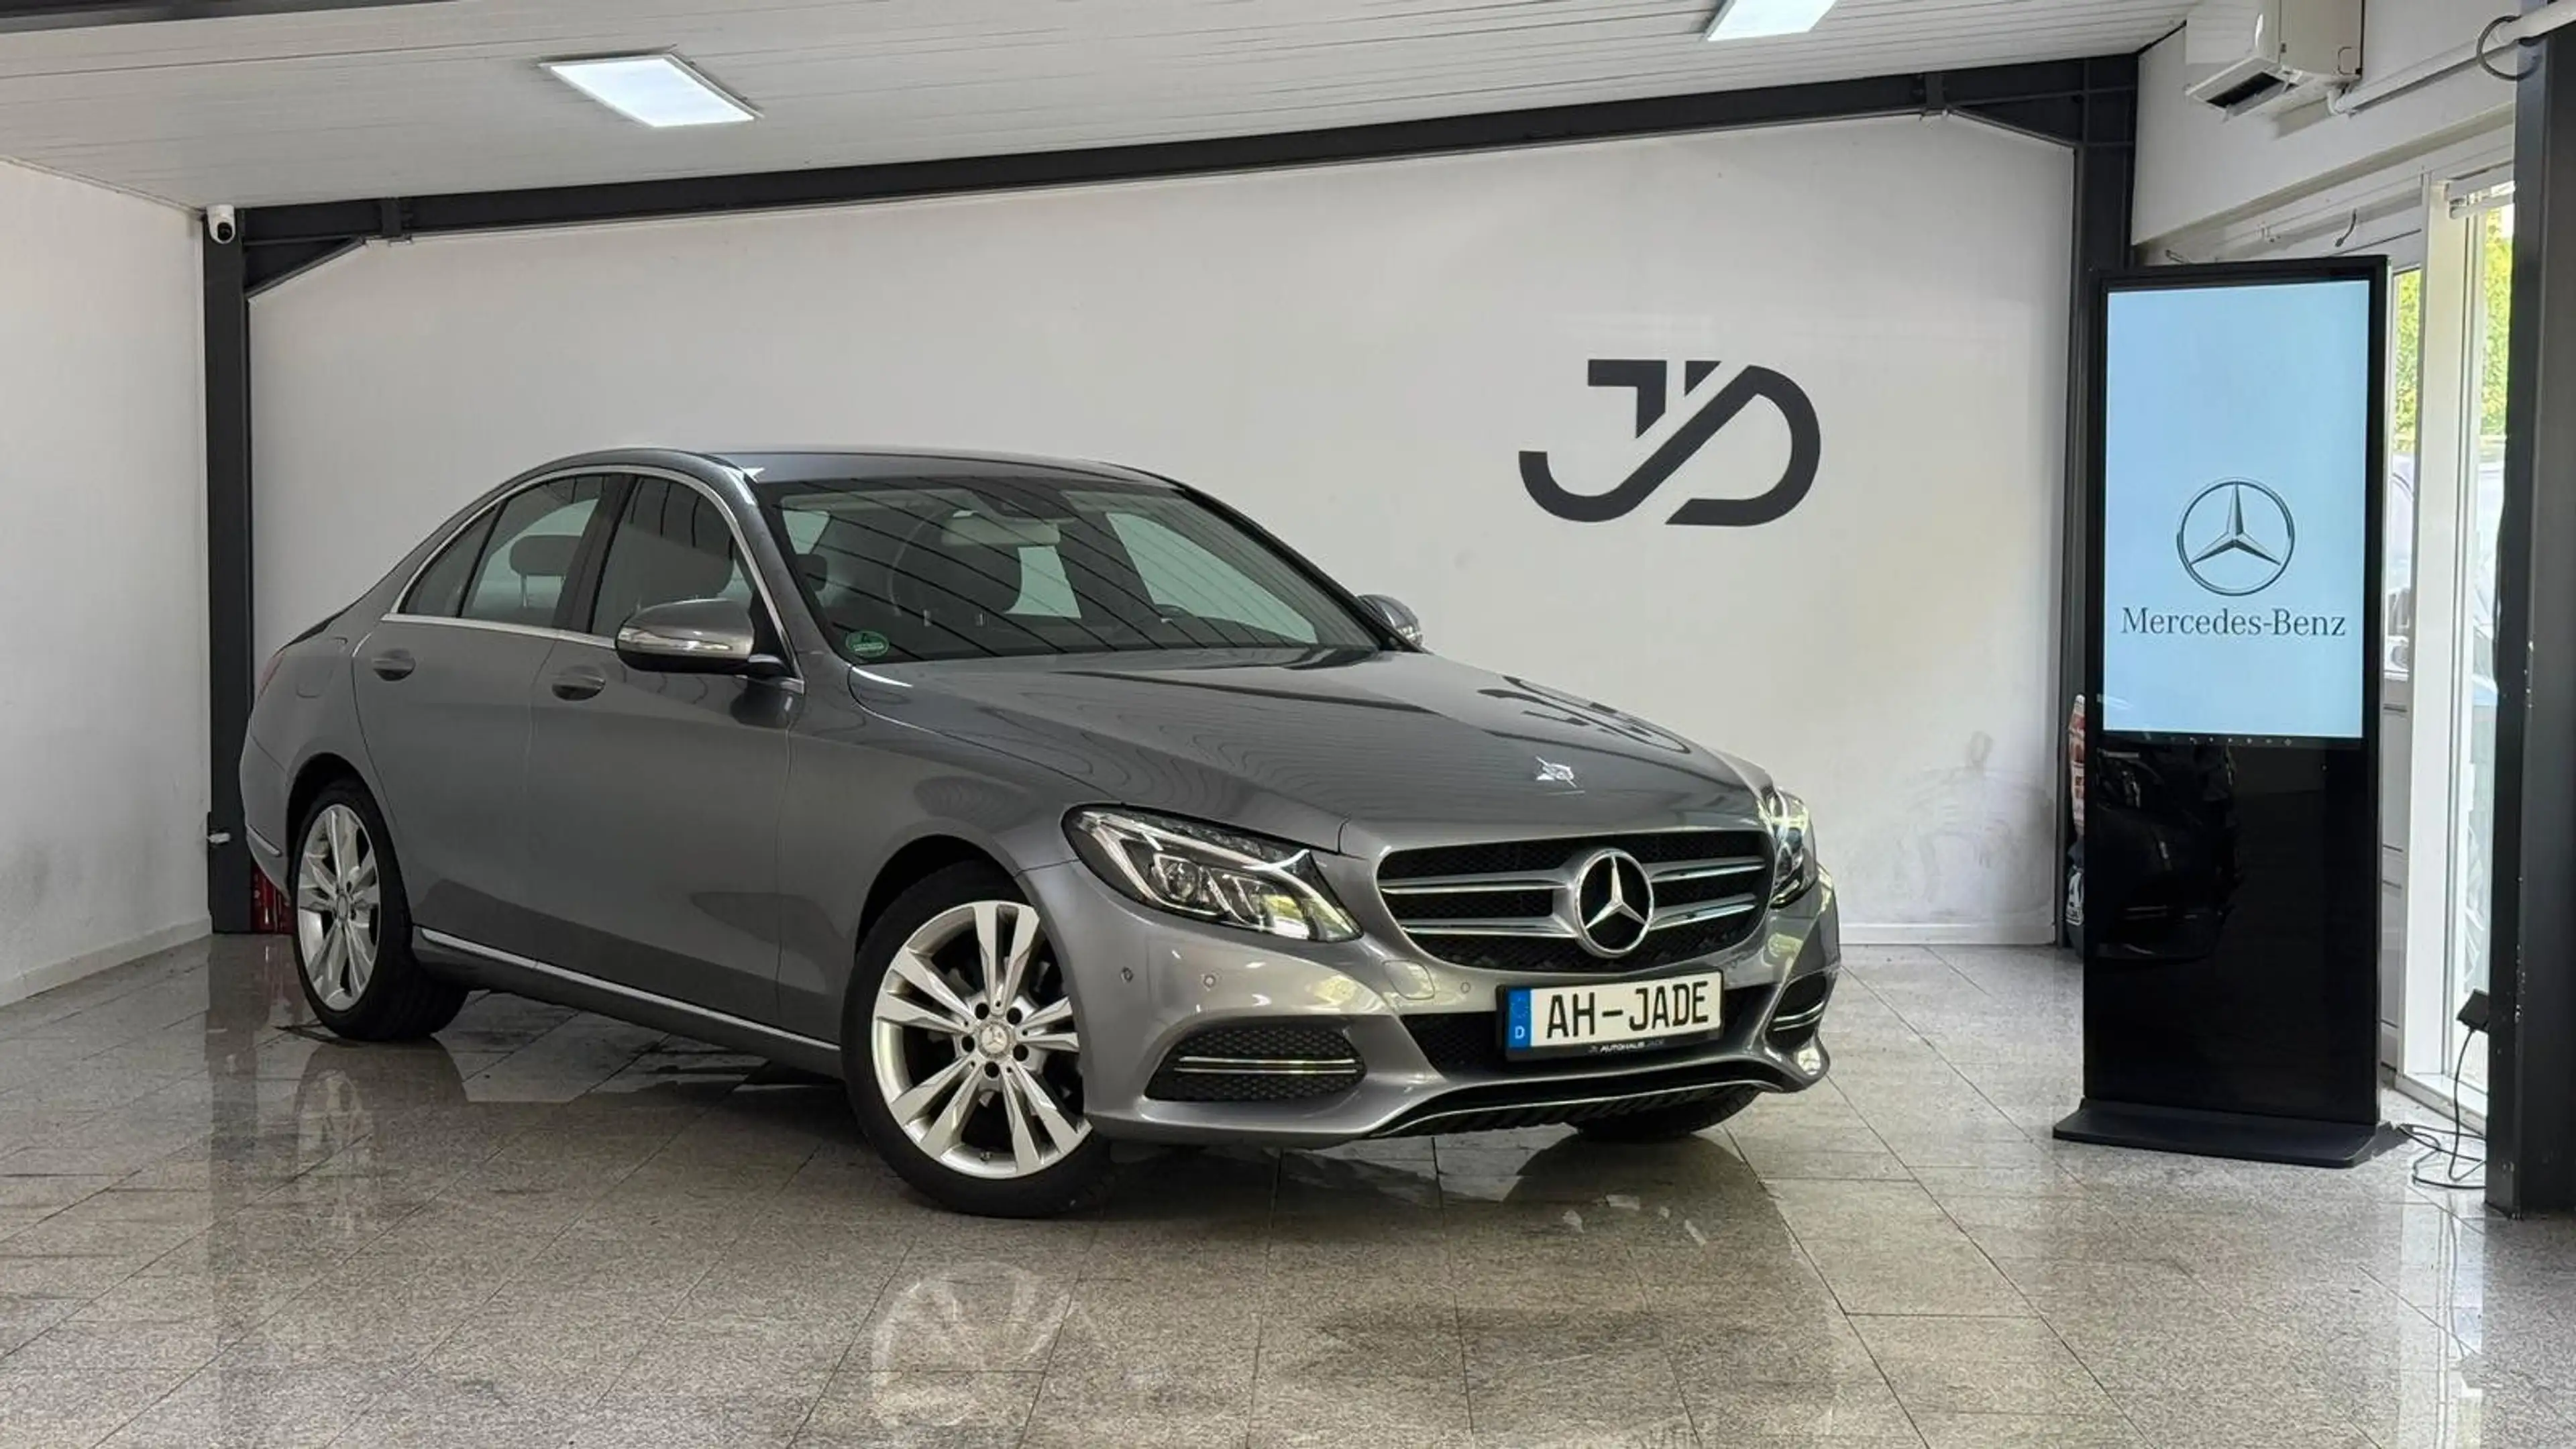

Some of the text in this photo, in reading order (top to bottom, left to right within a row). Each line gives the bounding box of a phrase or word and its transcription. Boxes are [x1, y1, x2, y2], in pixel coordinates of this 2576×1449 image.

[2120, 606, 2346, 637] Mercedes-Benz
[1546, 981, 1709, 1039] AH-JADE
[1515, 1026, 1525, 1039] D
